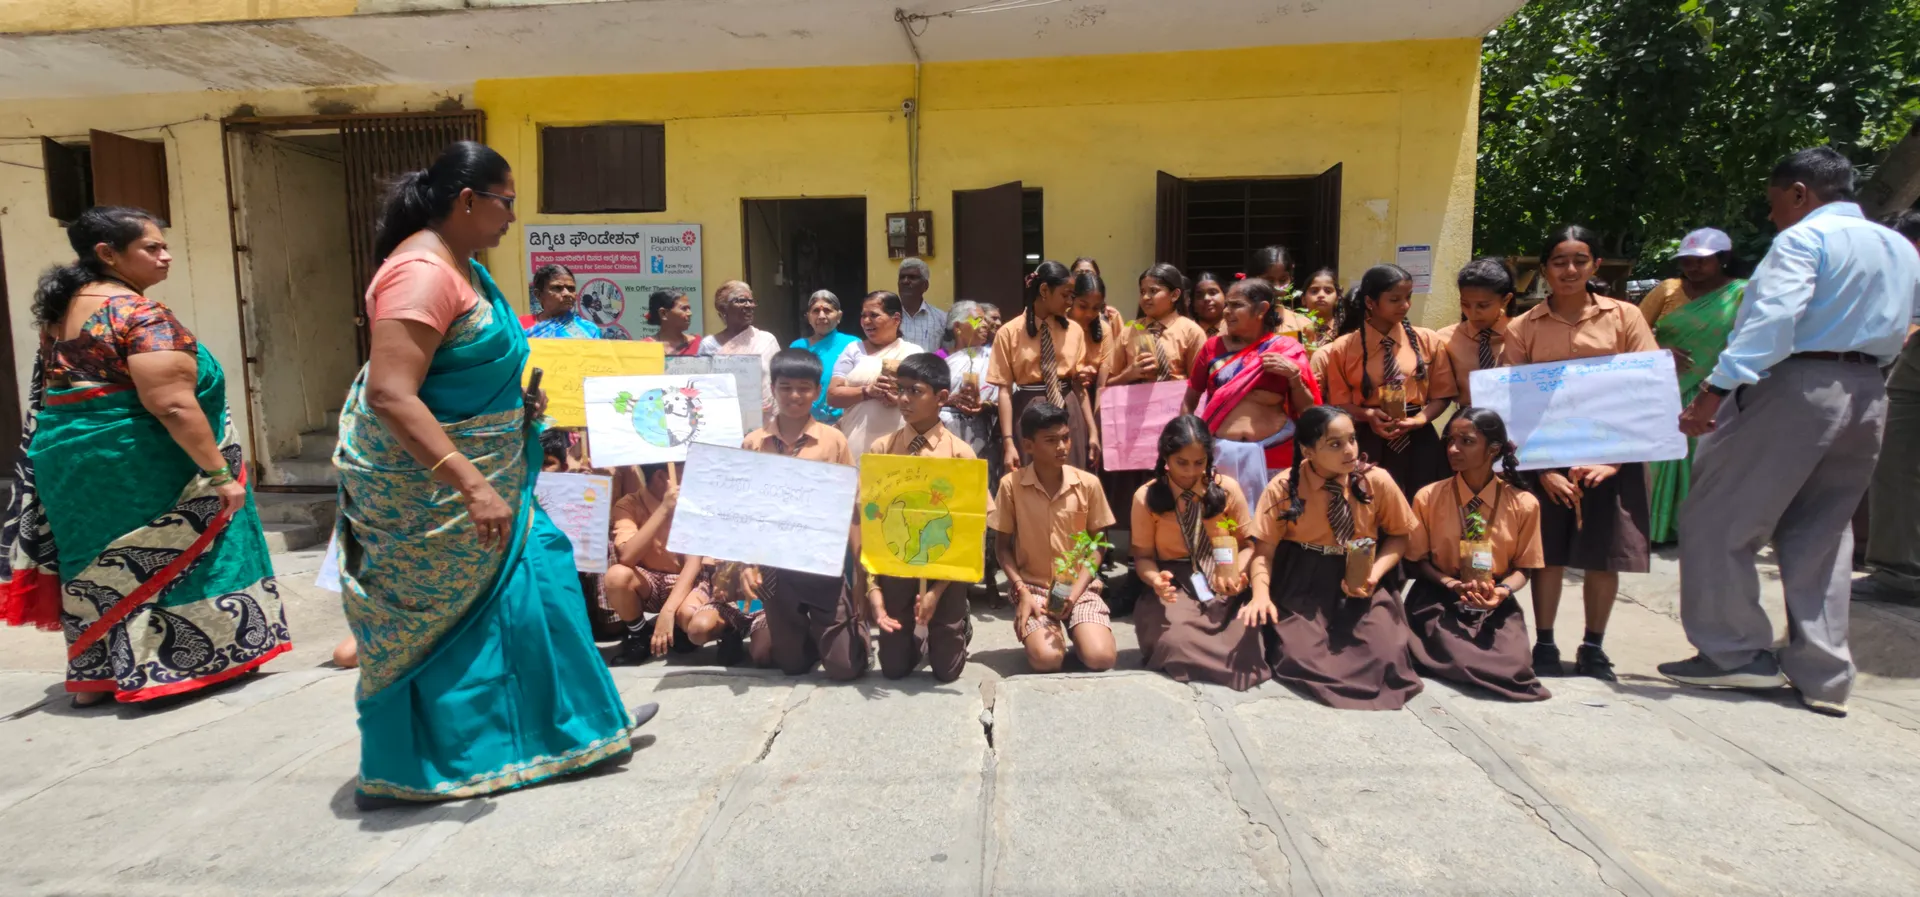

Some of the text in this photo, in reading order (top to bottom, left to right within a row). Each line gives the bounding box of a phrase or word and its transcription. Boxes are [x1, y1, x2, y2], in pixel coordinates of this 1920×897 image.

[529, 230, 640, 252] ಡಿಗ್ನಿಟಿ ಫೌಂಡೇಶನ್
[650, 236, 680, 244] Dignity
[651, 244, 692, 252] Foundation
